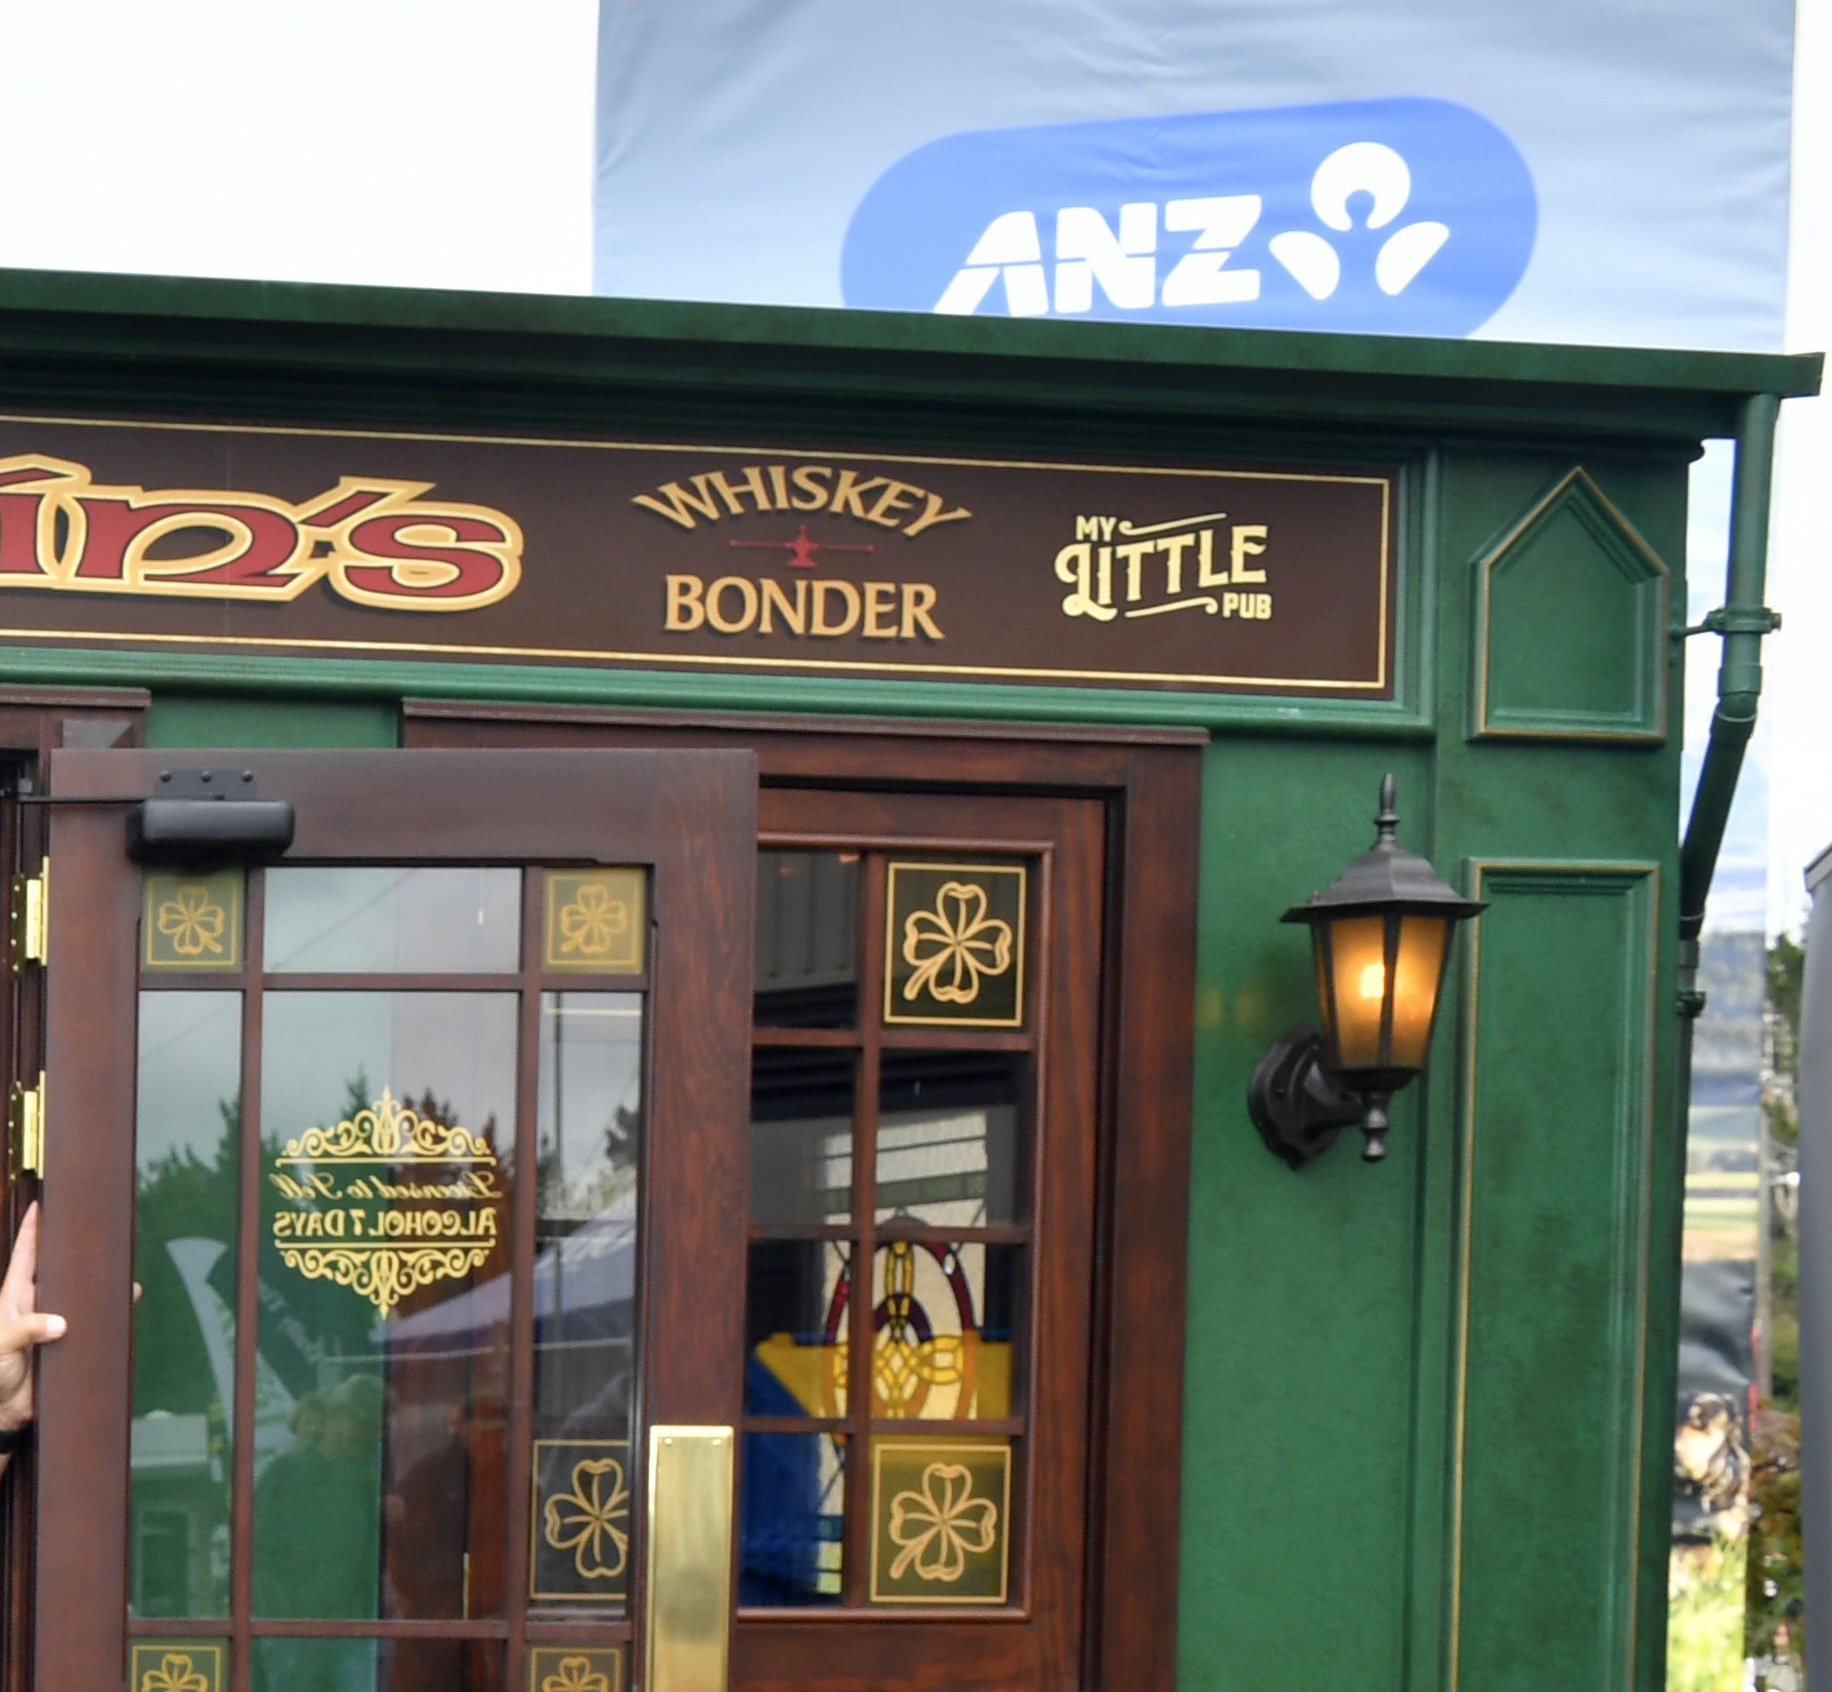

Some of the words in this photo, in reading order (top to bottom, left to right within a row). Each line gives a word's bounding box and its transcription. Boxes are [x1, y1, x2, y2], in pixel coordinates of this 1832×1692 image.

[933, 194, 1264, 318] ANZ
[630, 464, 973, 538] WHISKEY
[1075, 514, 1118, 542] MY
[664, 573, 946, 641] BONDER
[1055, 524, 1269, 622] LITTLE
[1222, 592, 1273, 620] PUB
